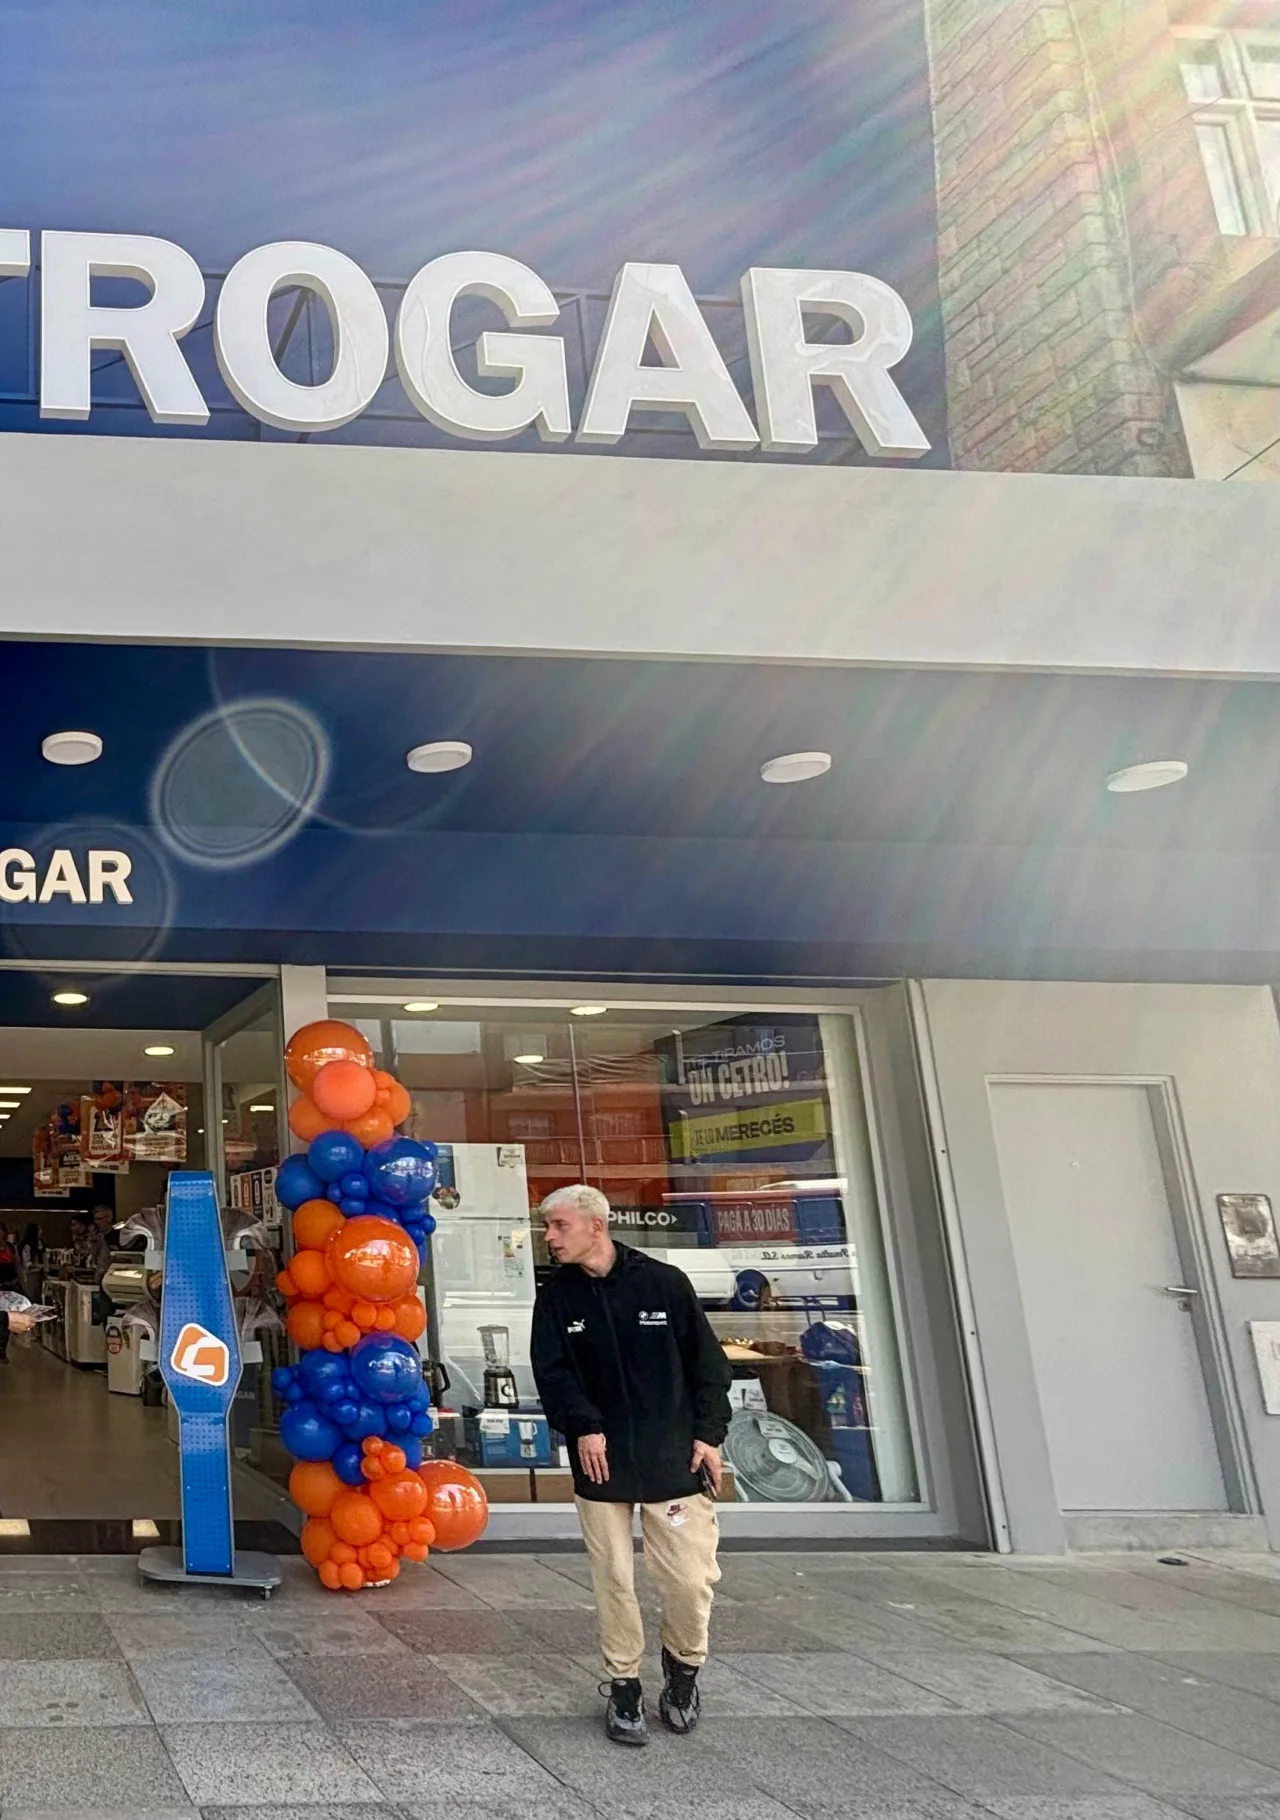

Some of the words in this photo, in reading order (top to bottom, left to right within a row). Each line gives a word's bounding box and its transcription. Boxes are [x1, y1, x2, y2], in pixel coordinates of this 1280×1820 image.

[718, 1050, 790, 1100] CETRO!
[715, 1113, 795, 1144] MERECÉS
[607, 1211, 671, 1226] PHILCO
[717, 1205, 743, 1233] PAGÁ
[744, 1210, 752, 1232] A
[751, 1208, 765, 1232] 30
[765, 1204, 790, 1232] DÍAS
